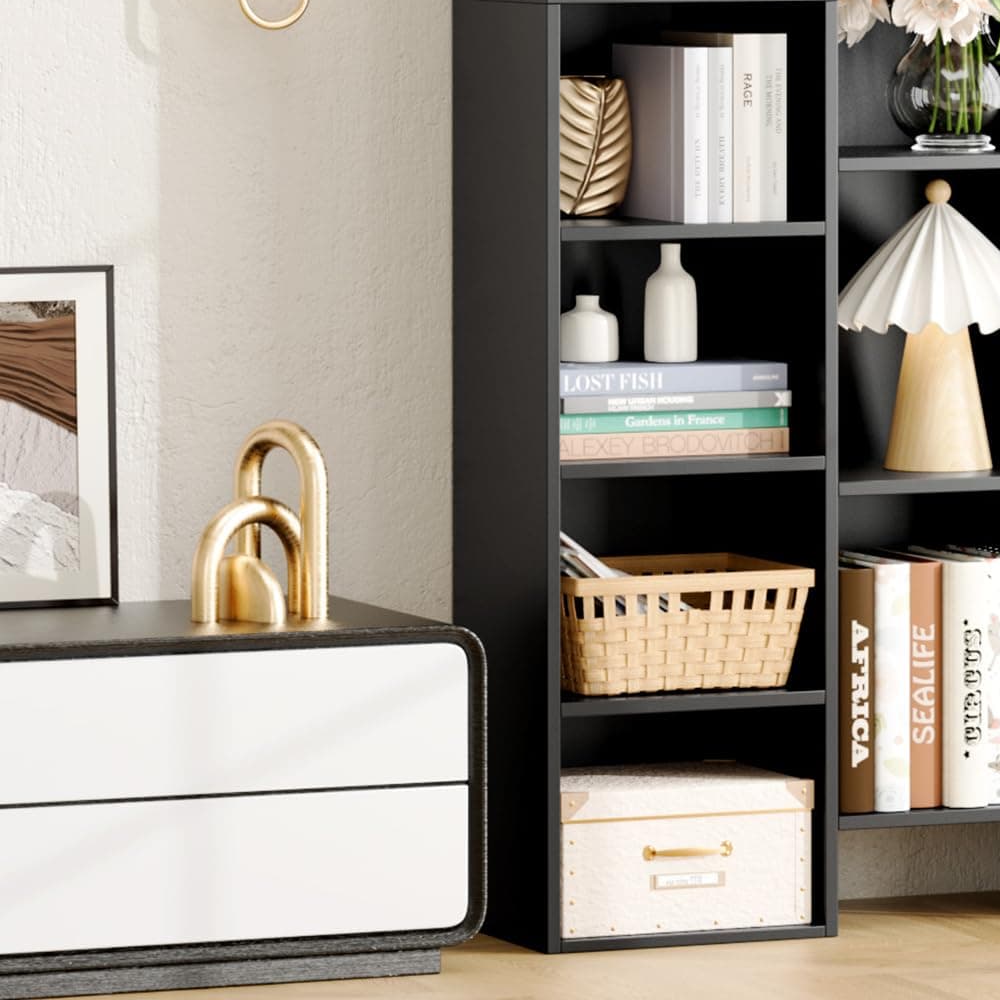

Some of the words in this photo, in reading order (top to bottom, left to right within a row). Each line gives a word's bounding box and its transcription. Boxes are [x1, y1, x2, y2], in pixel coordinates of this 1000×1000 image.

[743, 73, 753, 107] RAGE
[563, 373, 616, 393] LOST
[619, 371, 664, 390] FISH
[624, 416, 671, 429] Gardens
[673, 414, 685, 426] in
[687, 413, 726, 426] France
[560, 435, 634, 457] ALEXEY
[641, 430, 774, 455] BRODOVITCH
[851, 619, 869, 768] AFRICA
[912, 623, 935, 744] SEALIFE
[963, 628, 982, 746] CIRCUS
